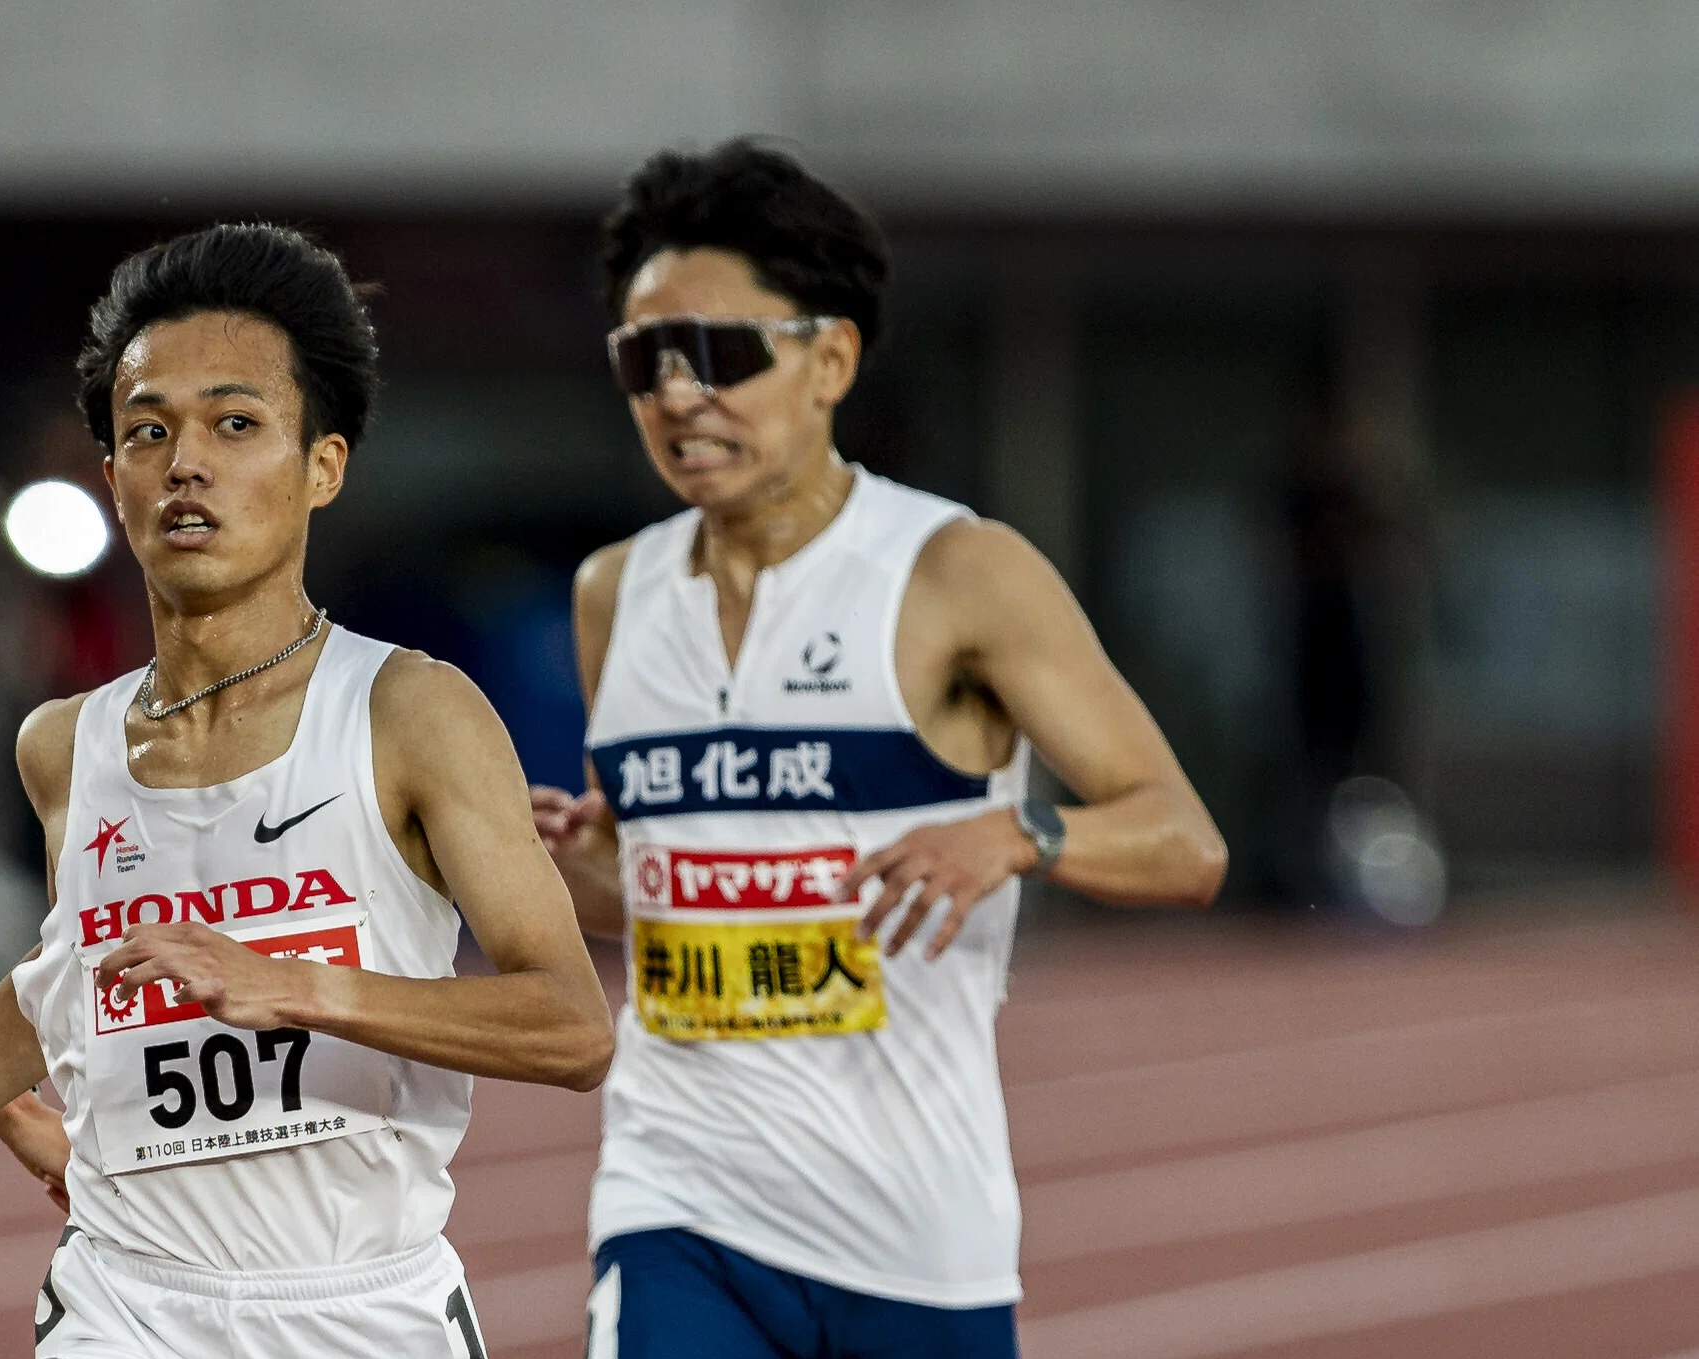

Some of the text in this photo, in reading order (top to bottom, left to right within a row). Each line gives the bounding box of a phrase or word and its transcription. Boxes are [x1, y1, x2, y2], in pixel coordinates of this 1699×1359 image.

[619, 740, 835, 803] 旭化成
[116, 853, 146, 864] Running
[117, 864, 136, 874] Team
[673, 859, 850, 902] ヤマザキ
[79, 868, 357, 947] HONDA
[644, 936, 866, 998] 井川 龍人
[143, 1029, 312, 1130] 507
[136, 1115, 347, 1161] 第110回 日本陸上競技選手権大会
